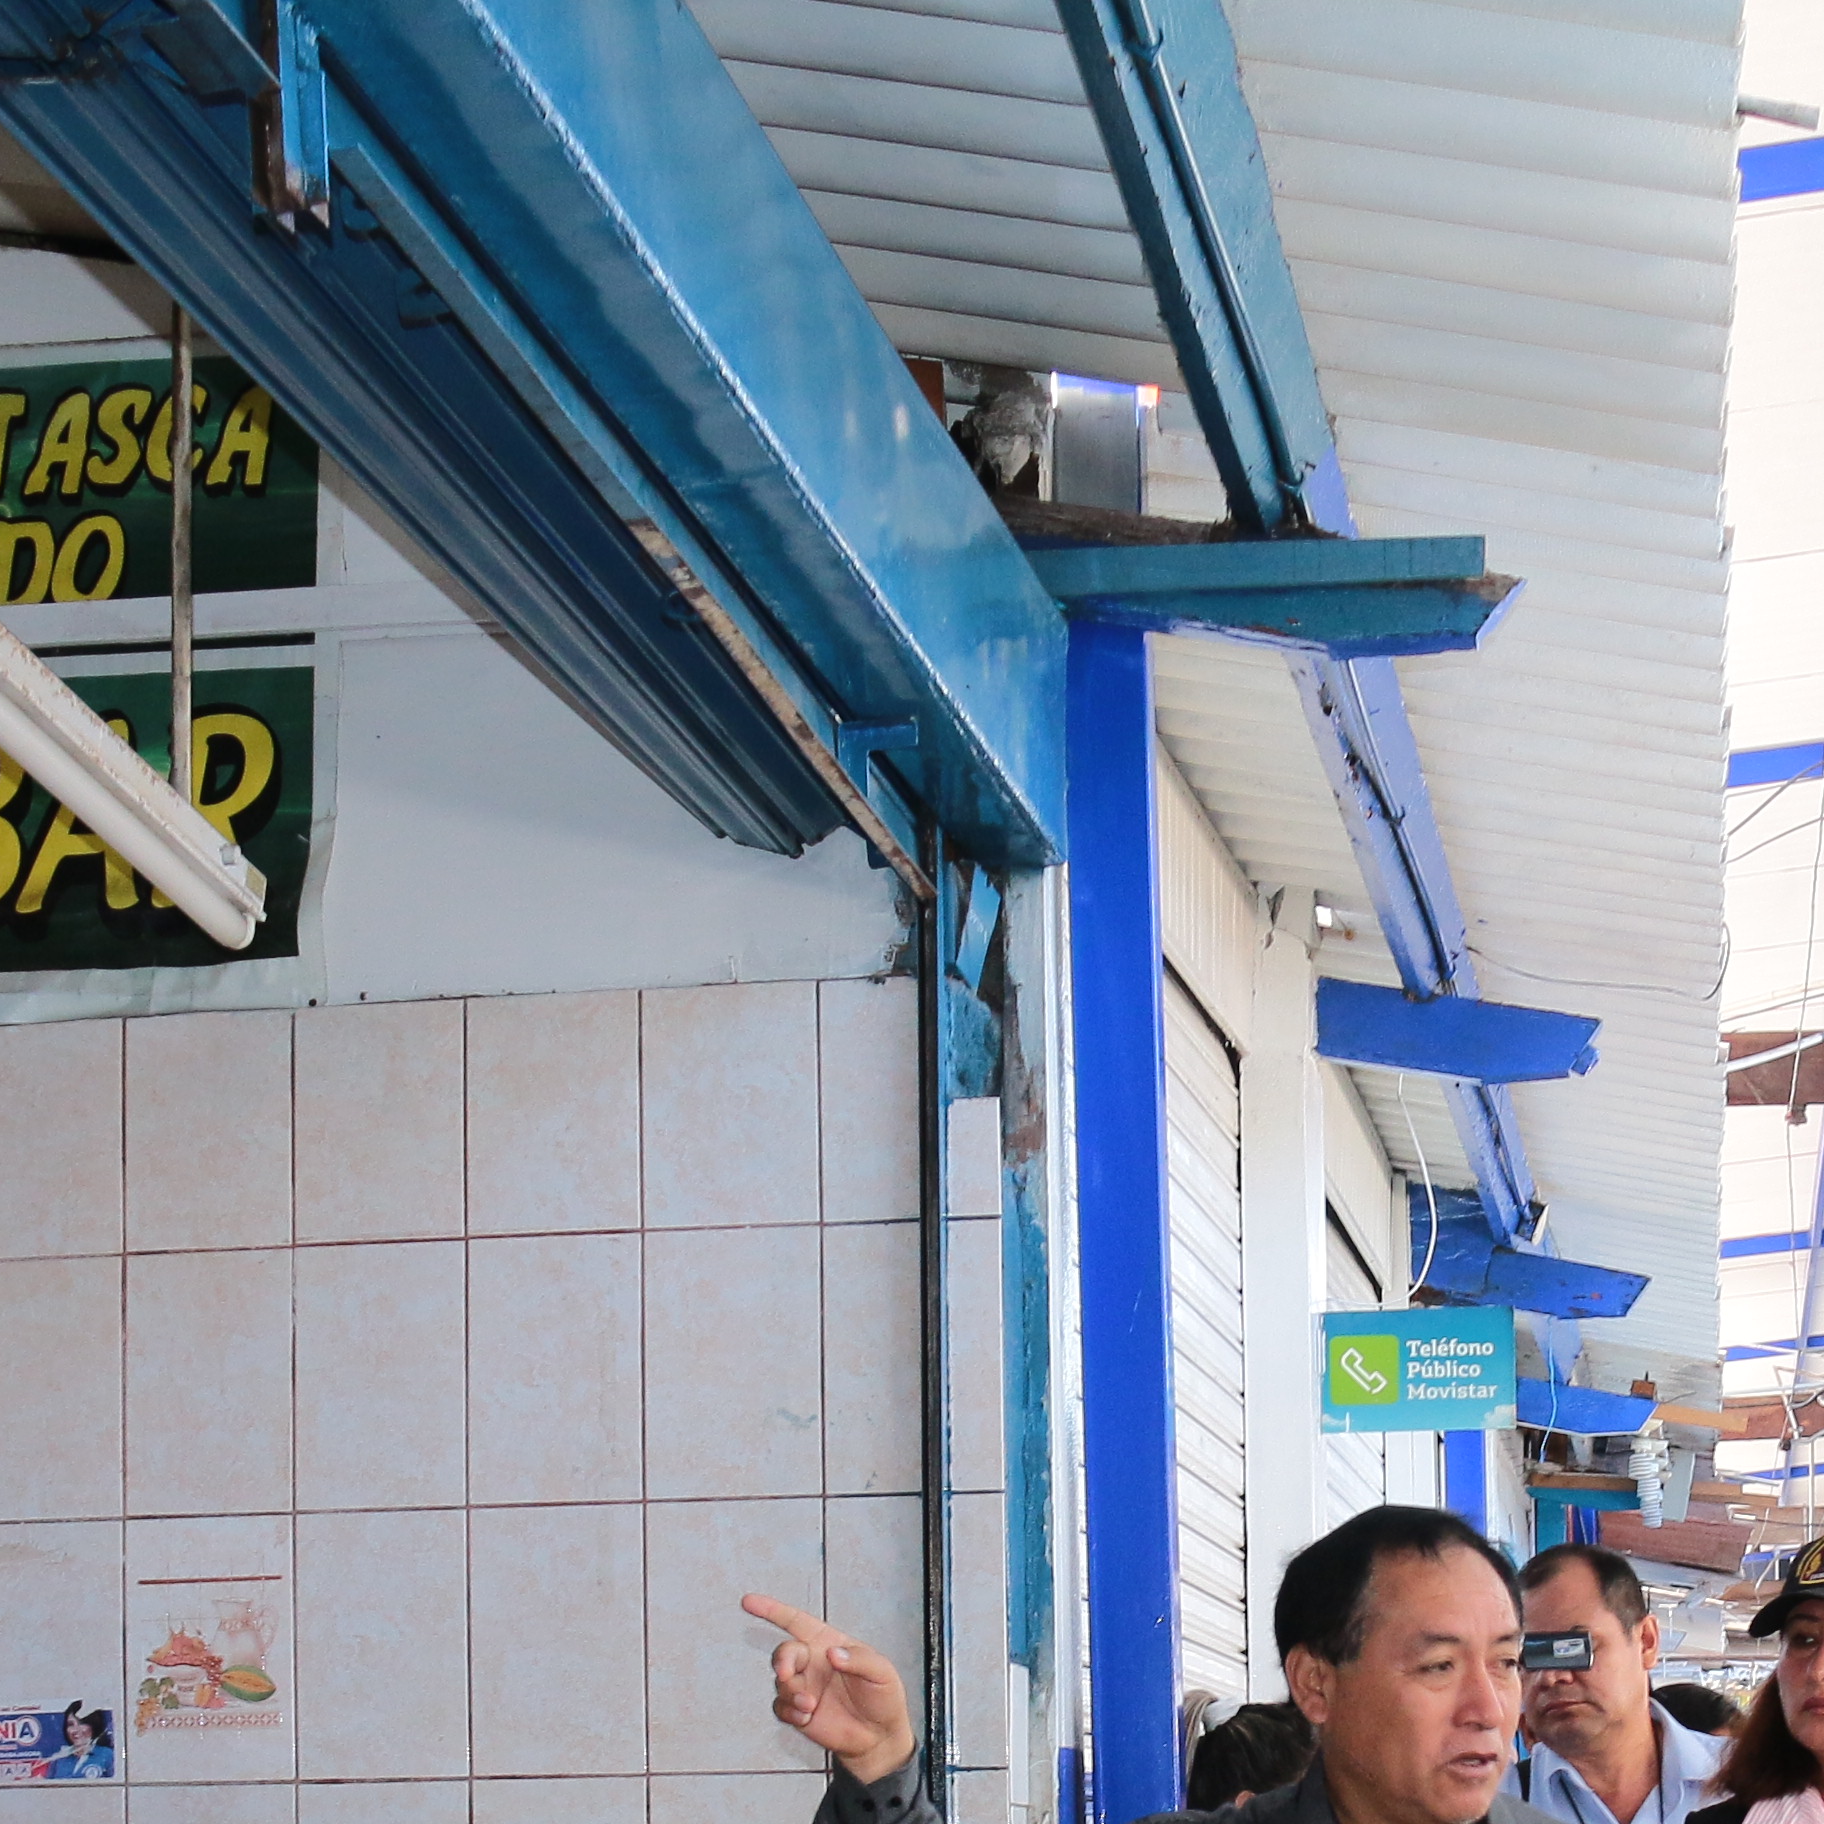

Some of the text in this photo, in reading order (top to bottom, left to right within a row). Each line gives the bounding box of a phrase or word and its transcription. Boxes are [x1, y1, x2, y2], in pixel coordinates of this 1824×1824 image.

[1405, 1336, 1495, 1358] Teléfono
[1406, 1358, 1482, 1380] Público
[1406, 1380, 1499, 1401] Movistar
